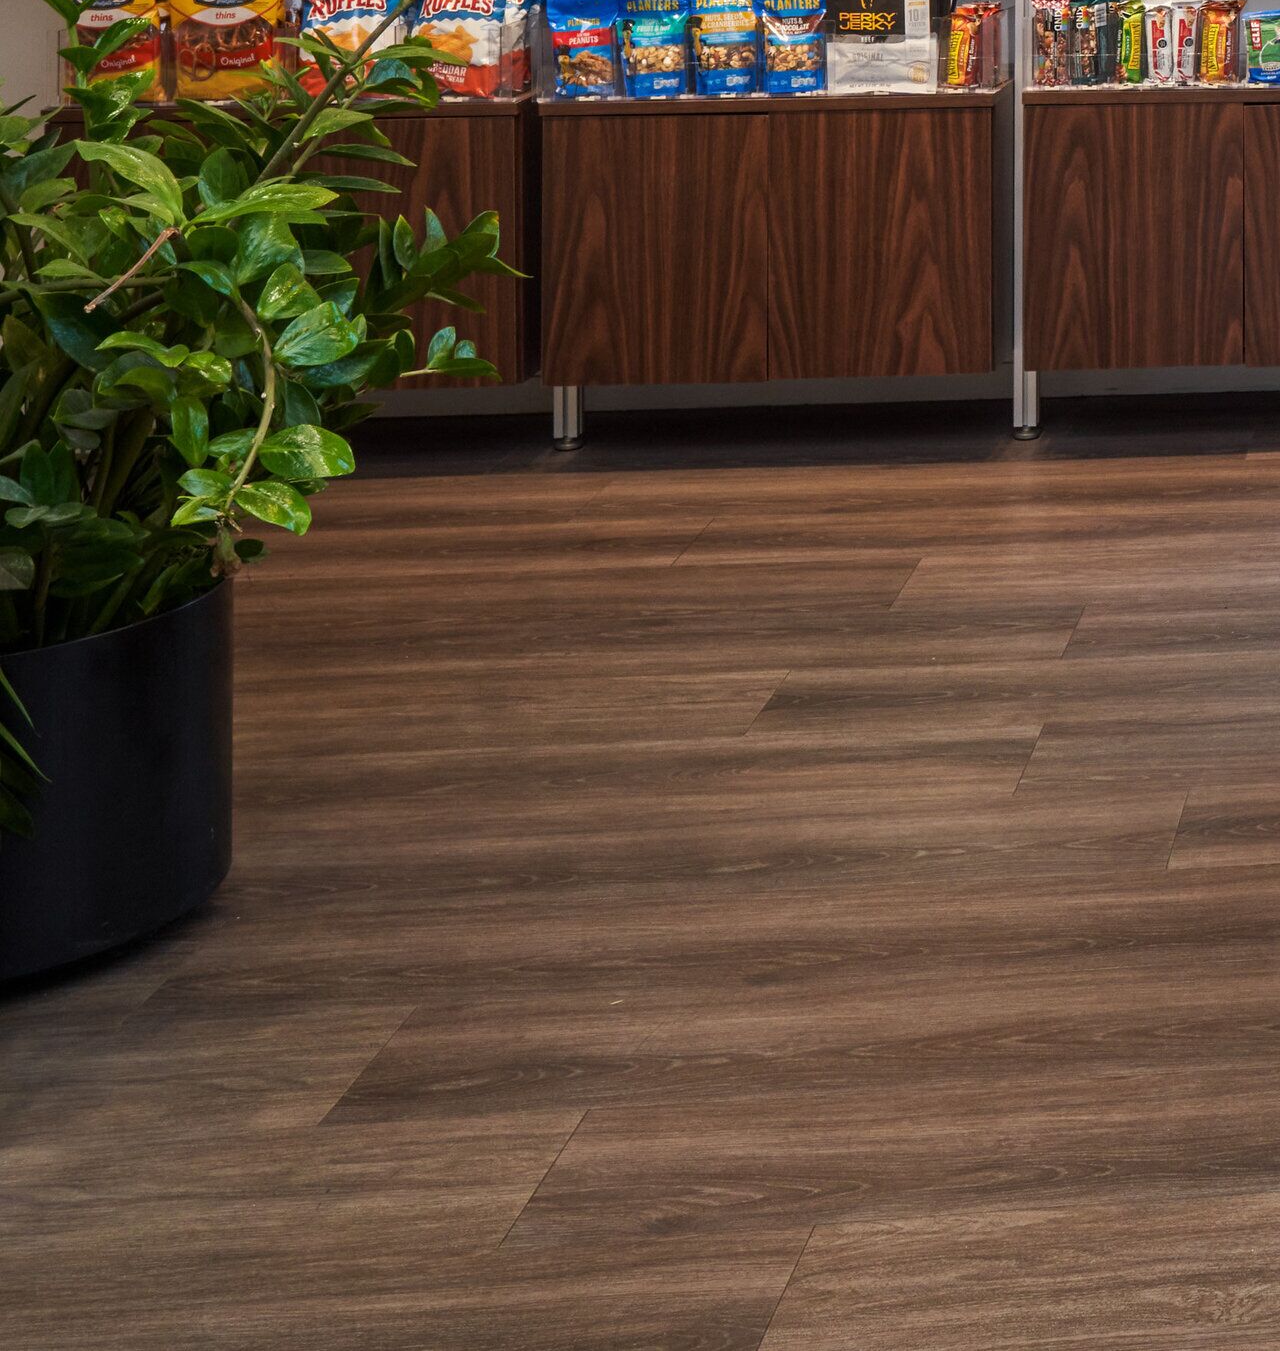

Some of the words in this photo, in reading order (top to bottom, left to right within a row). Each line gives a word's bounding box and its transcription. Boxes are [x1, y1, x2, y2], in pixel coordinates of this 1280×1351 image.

[215, 11, 237, 21] thins
[840, 12, 895, 22] PERKY
[840, 22, 895, 31] JERKY
[569, 36, 599, 45] PEANUTS
[220, 53, 255, 68] Original
